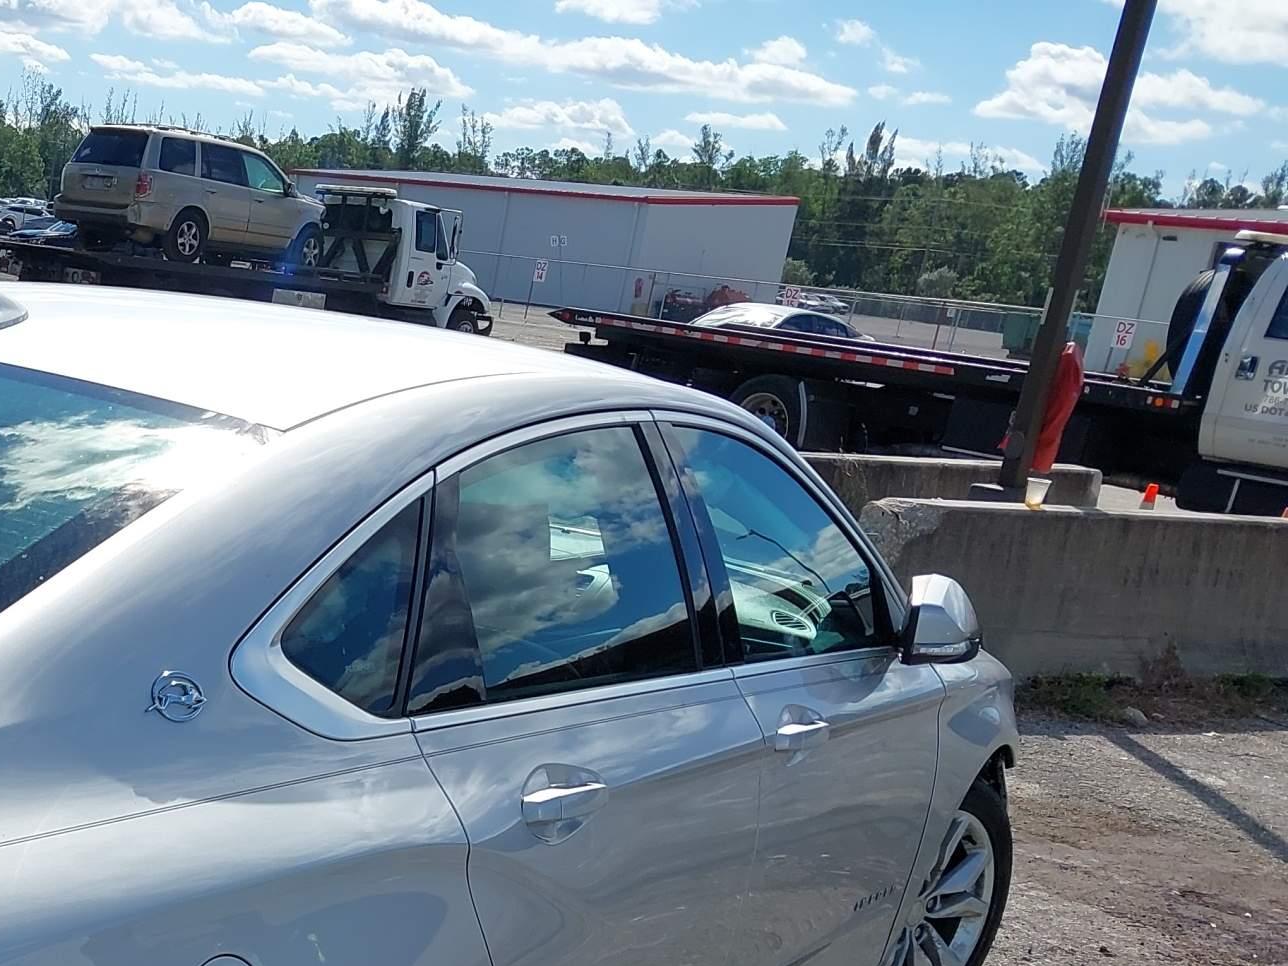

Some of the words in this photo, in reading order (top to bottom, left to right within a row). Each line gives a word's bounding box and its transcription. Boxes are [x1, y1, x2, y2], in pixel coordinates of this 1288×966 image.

[536, 261, 548, 271] DZ
[785, 288, 800, 299] DZ
[1116, 321, 1136, 335] DZ
[1115, 334, 1128, 346] 16
[1244, 402, 1258, 413] US
